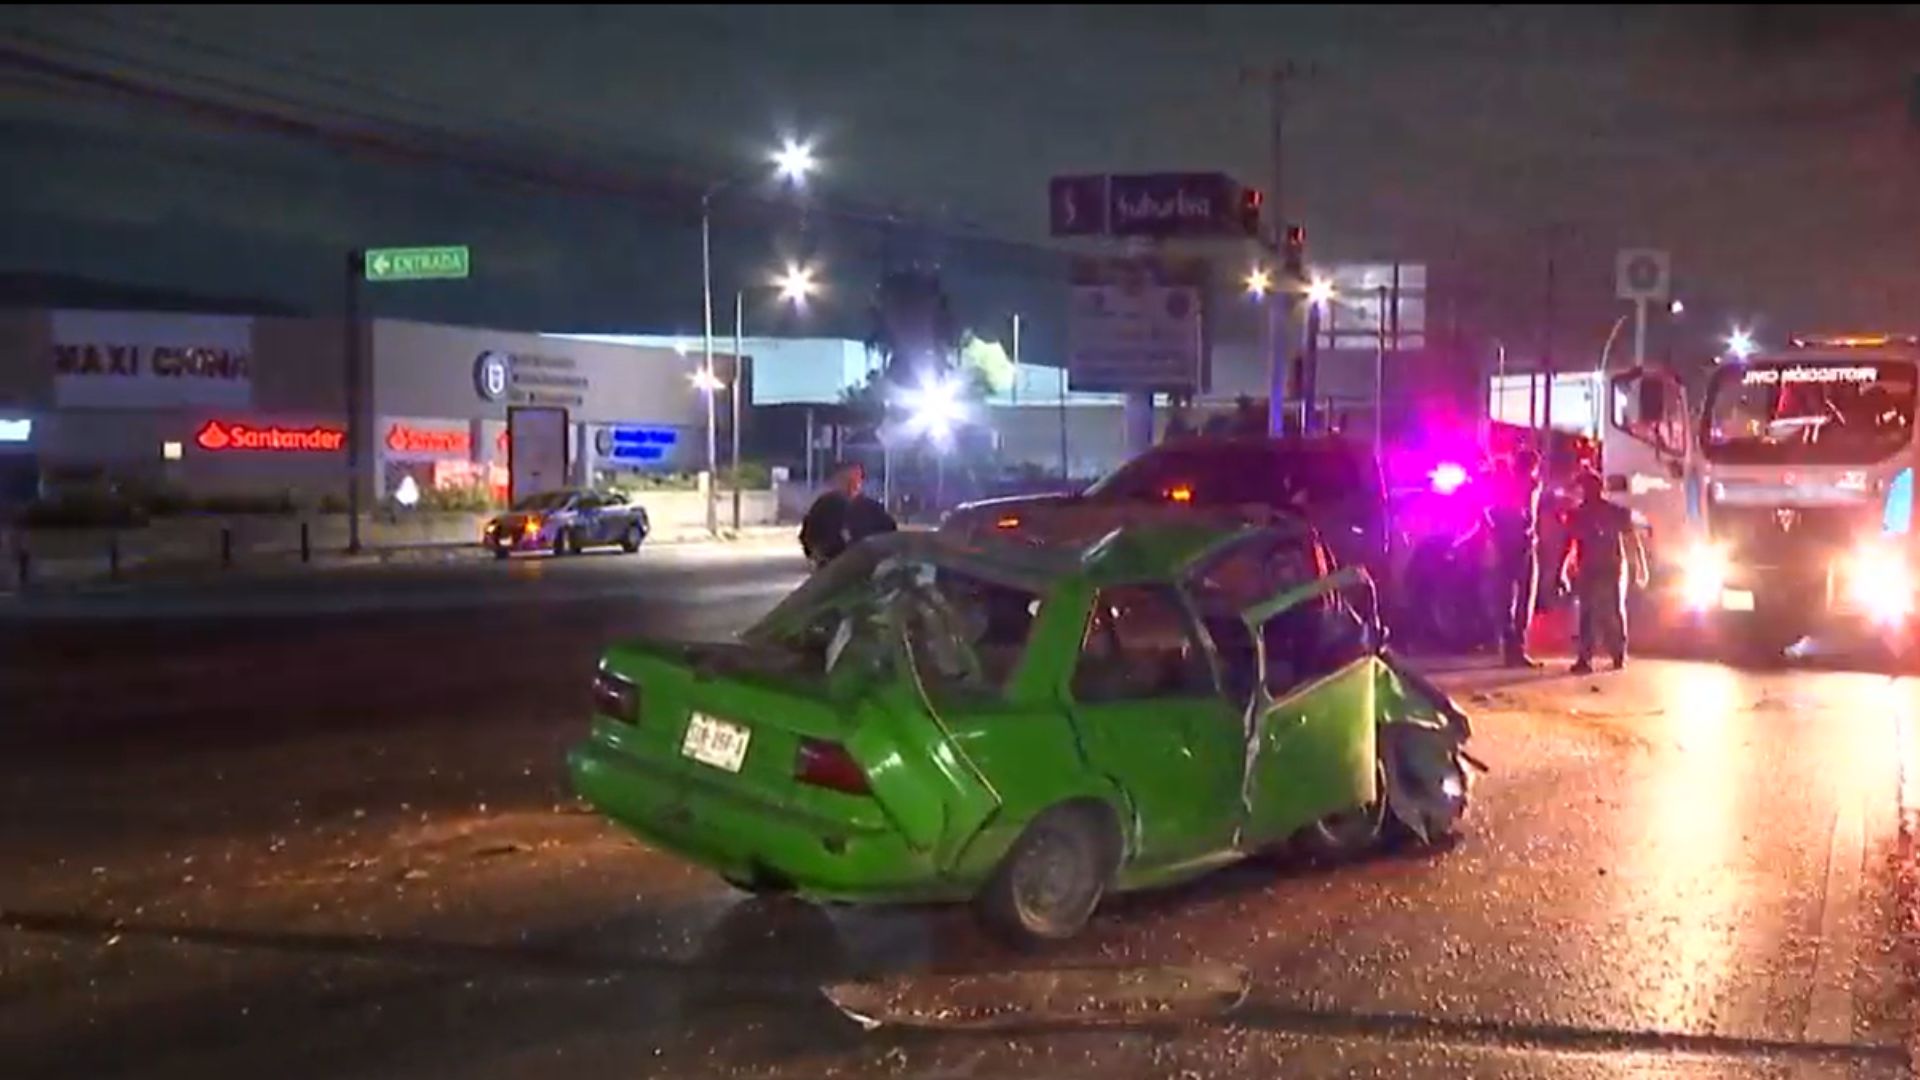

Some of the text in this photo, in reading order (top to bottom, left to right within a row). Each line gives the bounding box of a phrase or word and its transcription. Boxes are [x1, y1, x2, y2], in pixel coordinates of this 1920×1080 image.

[393, 253, 463, 273] ENTRADA
[53, 344, 138, 375] MAXI
[230, 426, 342, 449] Santander
